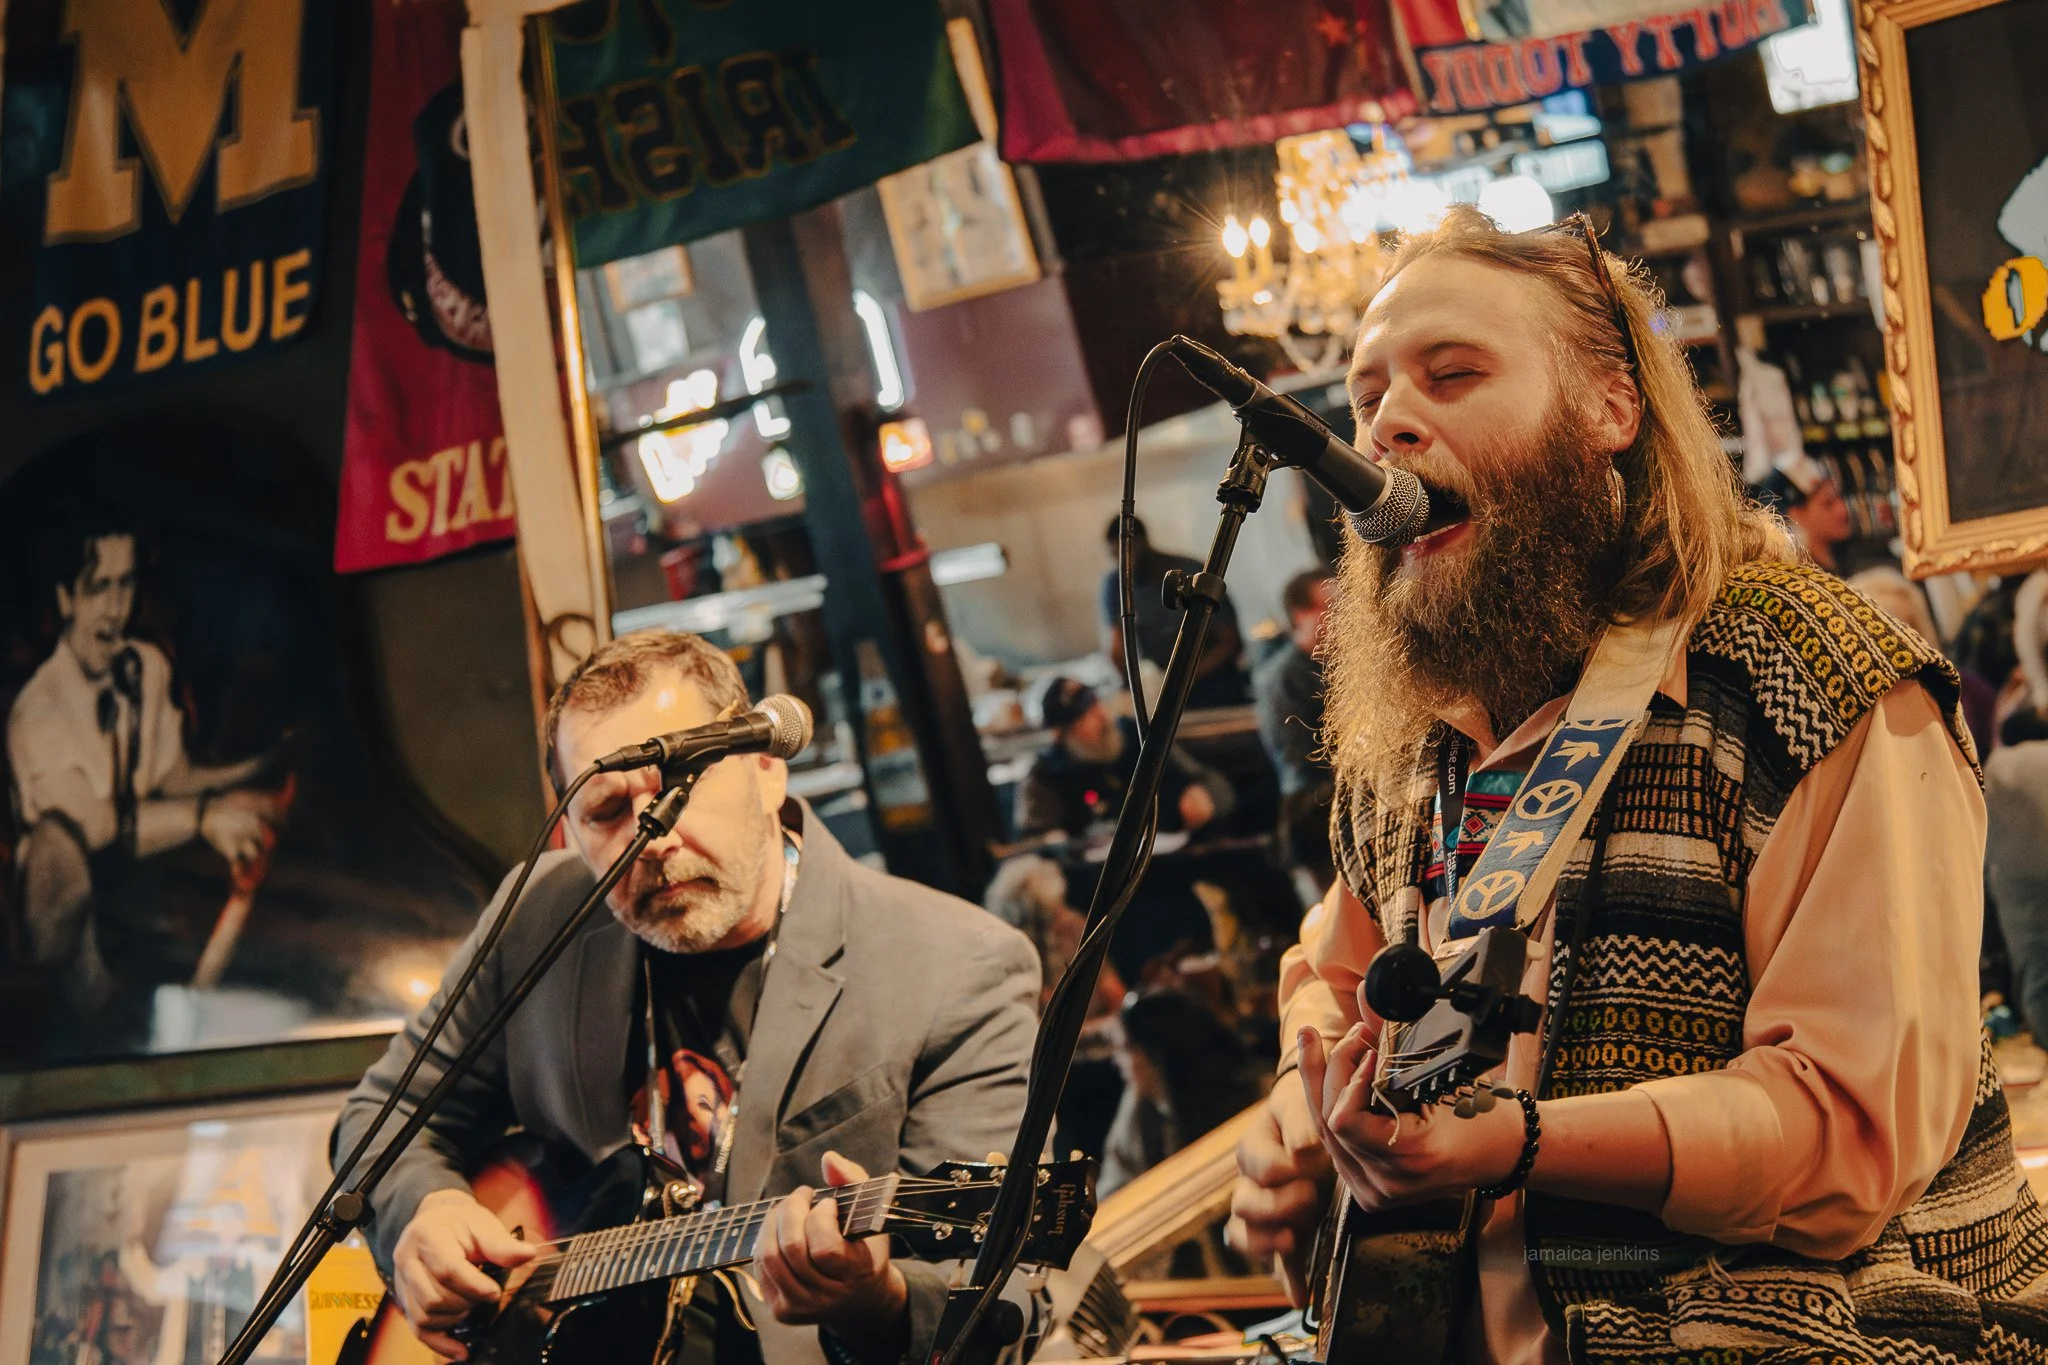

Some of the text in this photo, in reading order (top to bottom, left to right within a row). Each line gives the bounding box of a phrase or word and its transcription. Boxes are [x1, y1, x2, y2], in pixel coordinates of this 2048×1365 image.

[43, 0, 321, 247] M
[28, 296, 122, 395] GO
[134, 248, 312, 375] BLUE
